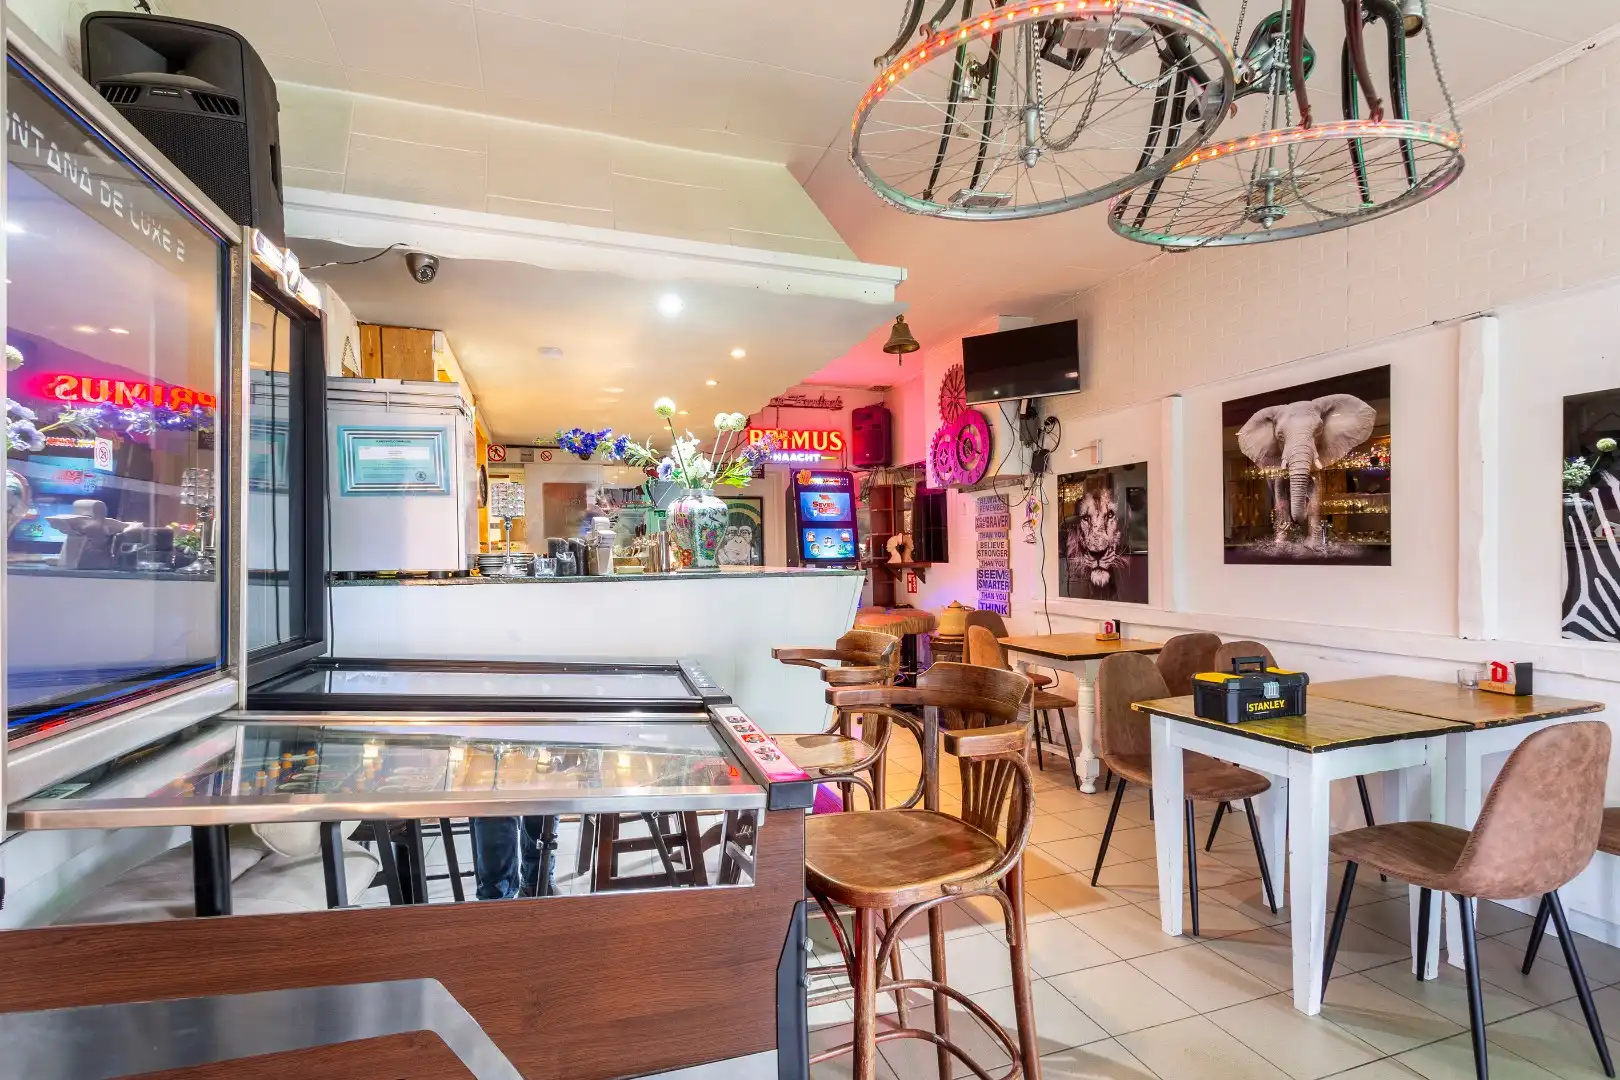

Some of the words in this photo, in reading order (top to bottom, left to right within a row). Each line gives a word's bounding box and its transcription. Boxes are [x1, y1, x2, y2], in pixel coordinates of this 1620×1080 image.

[6, 110, 93, 196] NTANA
[100, 179, 124, 218] DE
[130, 203, 171, 253] LUXE
[986, 515, 1009, 528] BRAVER
[980, 541, 1005, 549] BELIEVE
[977, 549, 1008, 557] STRONGER
[995, 560, 1006, 568] YOU
[978, 569, 1005, 579] SEEM
[978, 579, 1009, 590] SMARTER
[981, 592, 994, 600] THAN
[995, 593, 1007, 601] YOU
[980, 602, 1008, 615] THINK
[1248, 699, 1286, 712] STANLEY
